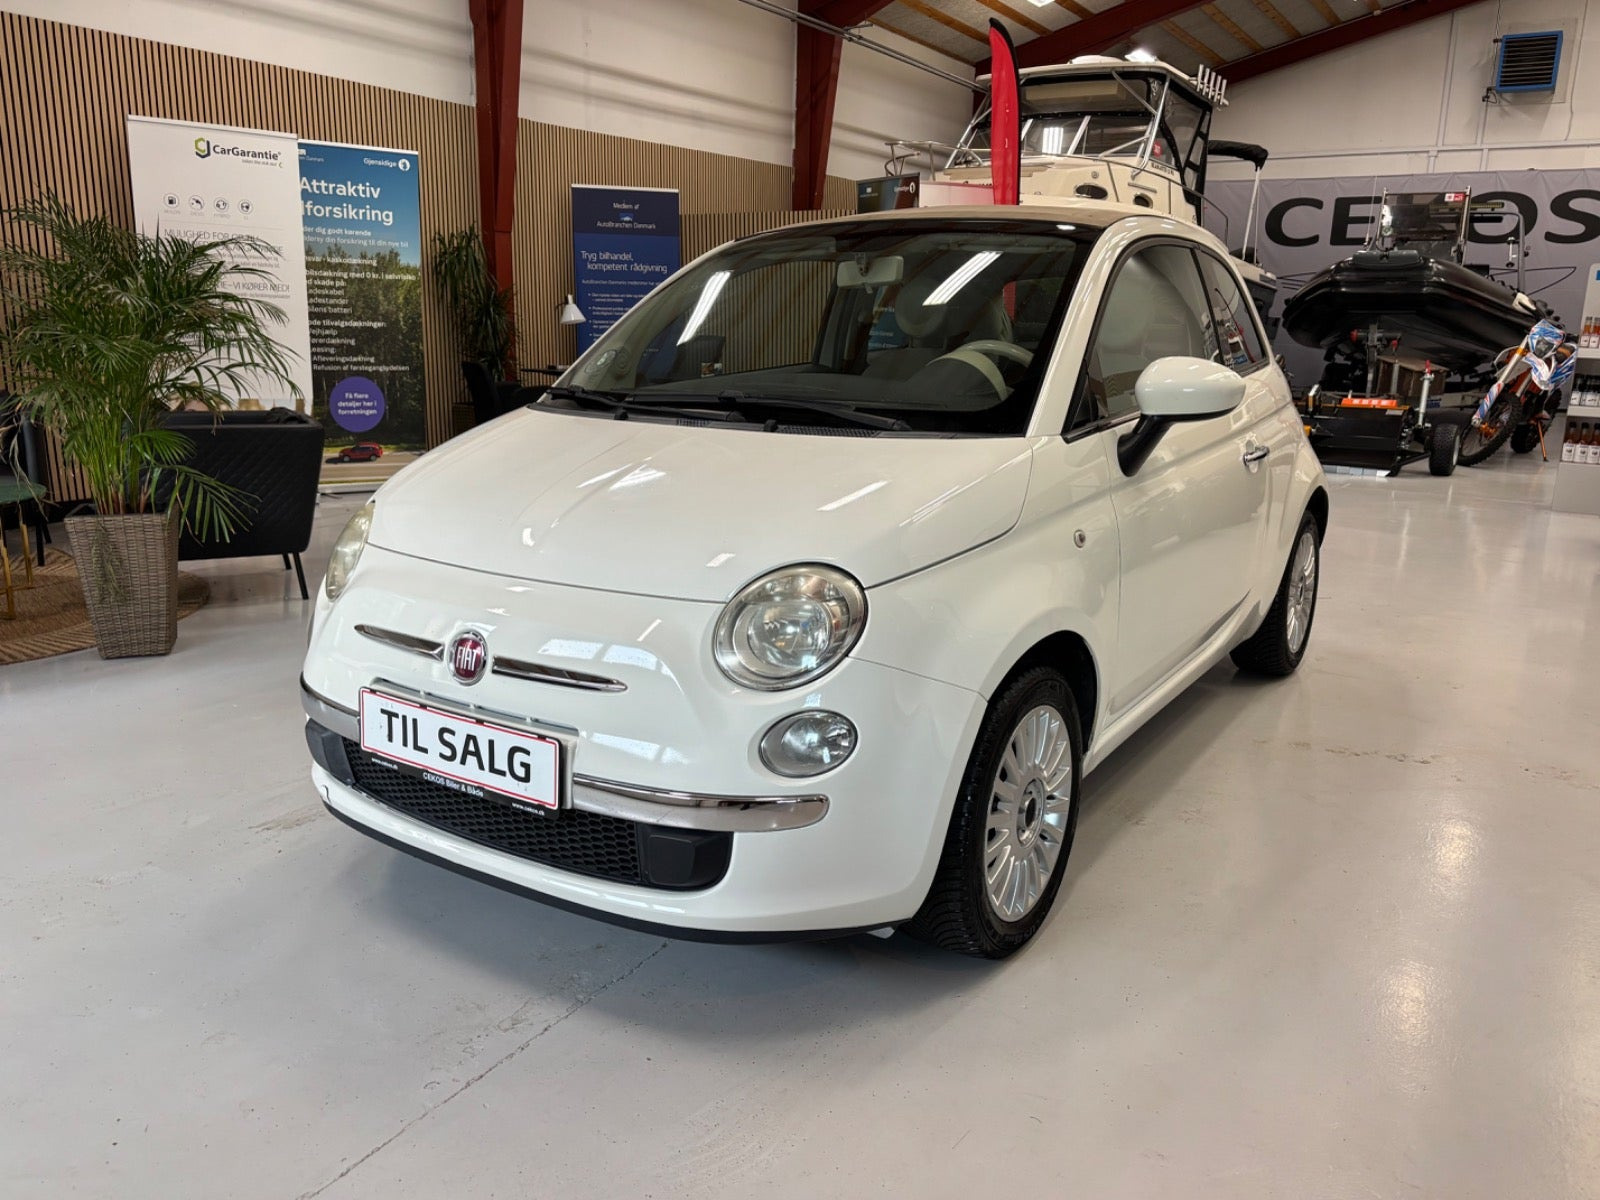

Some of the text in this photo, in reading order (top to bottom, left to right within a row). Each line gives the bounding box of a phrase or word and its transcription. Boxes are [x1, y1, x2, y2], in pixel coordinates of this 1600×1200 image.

[212, 144, 279, 161] CarGarantie
[363, 157, 397, 168] Gjensidige
[300, 177, 381, 199] Attraktiv
[1265, 189, 1600, 247] CEOS
[315, 227, 327, 235] dig
[327, 229, 343, 237] godt
[344, 229, 371, 237] kørende
[580, 251, 634, 261] Tryg bilhandel,
[349, 271, 365, 279] med
[587, 262, 668, 274] kompetent rådgivning
[337, 401, 362, 409] detaljer
[455, 645, 479, 672] FIAT
[380, 707, 531, 784] TIL SALG
[422, 771, 484, 797] CEKOS Biler & Både
